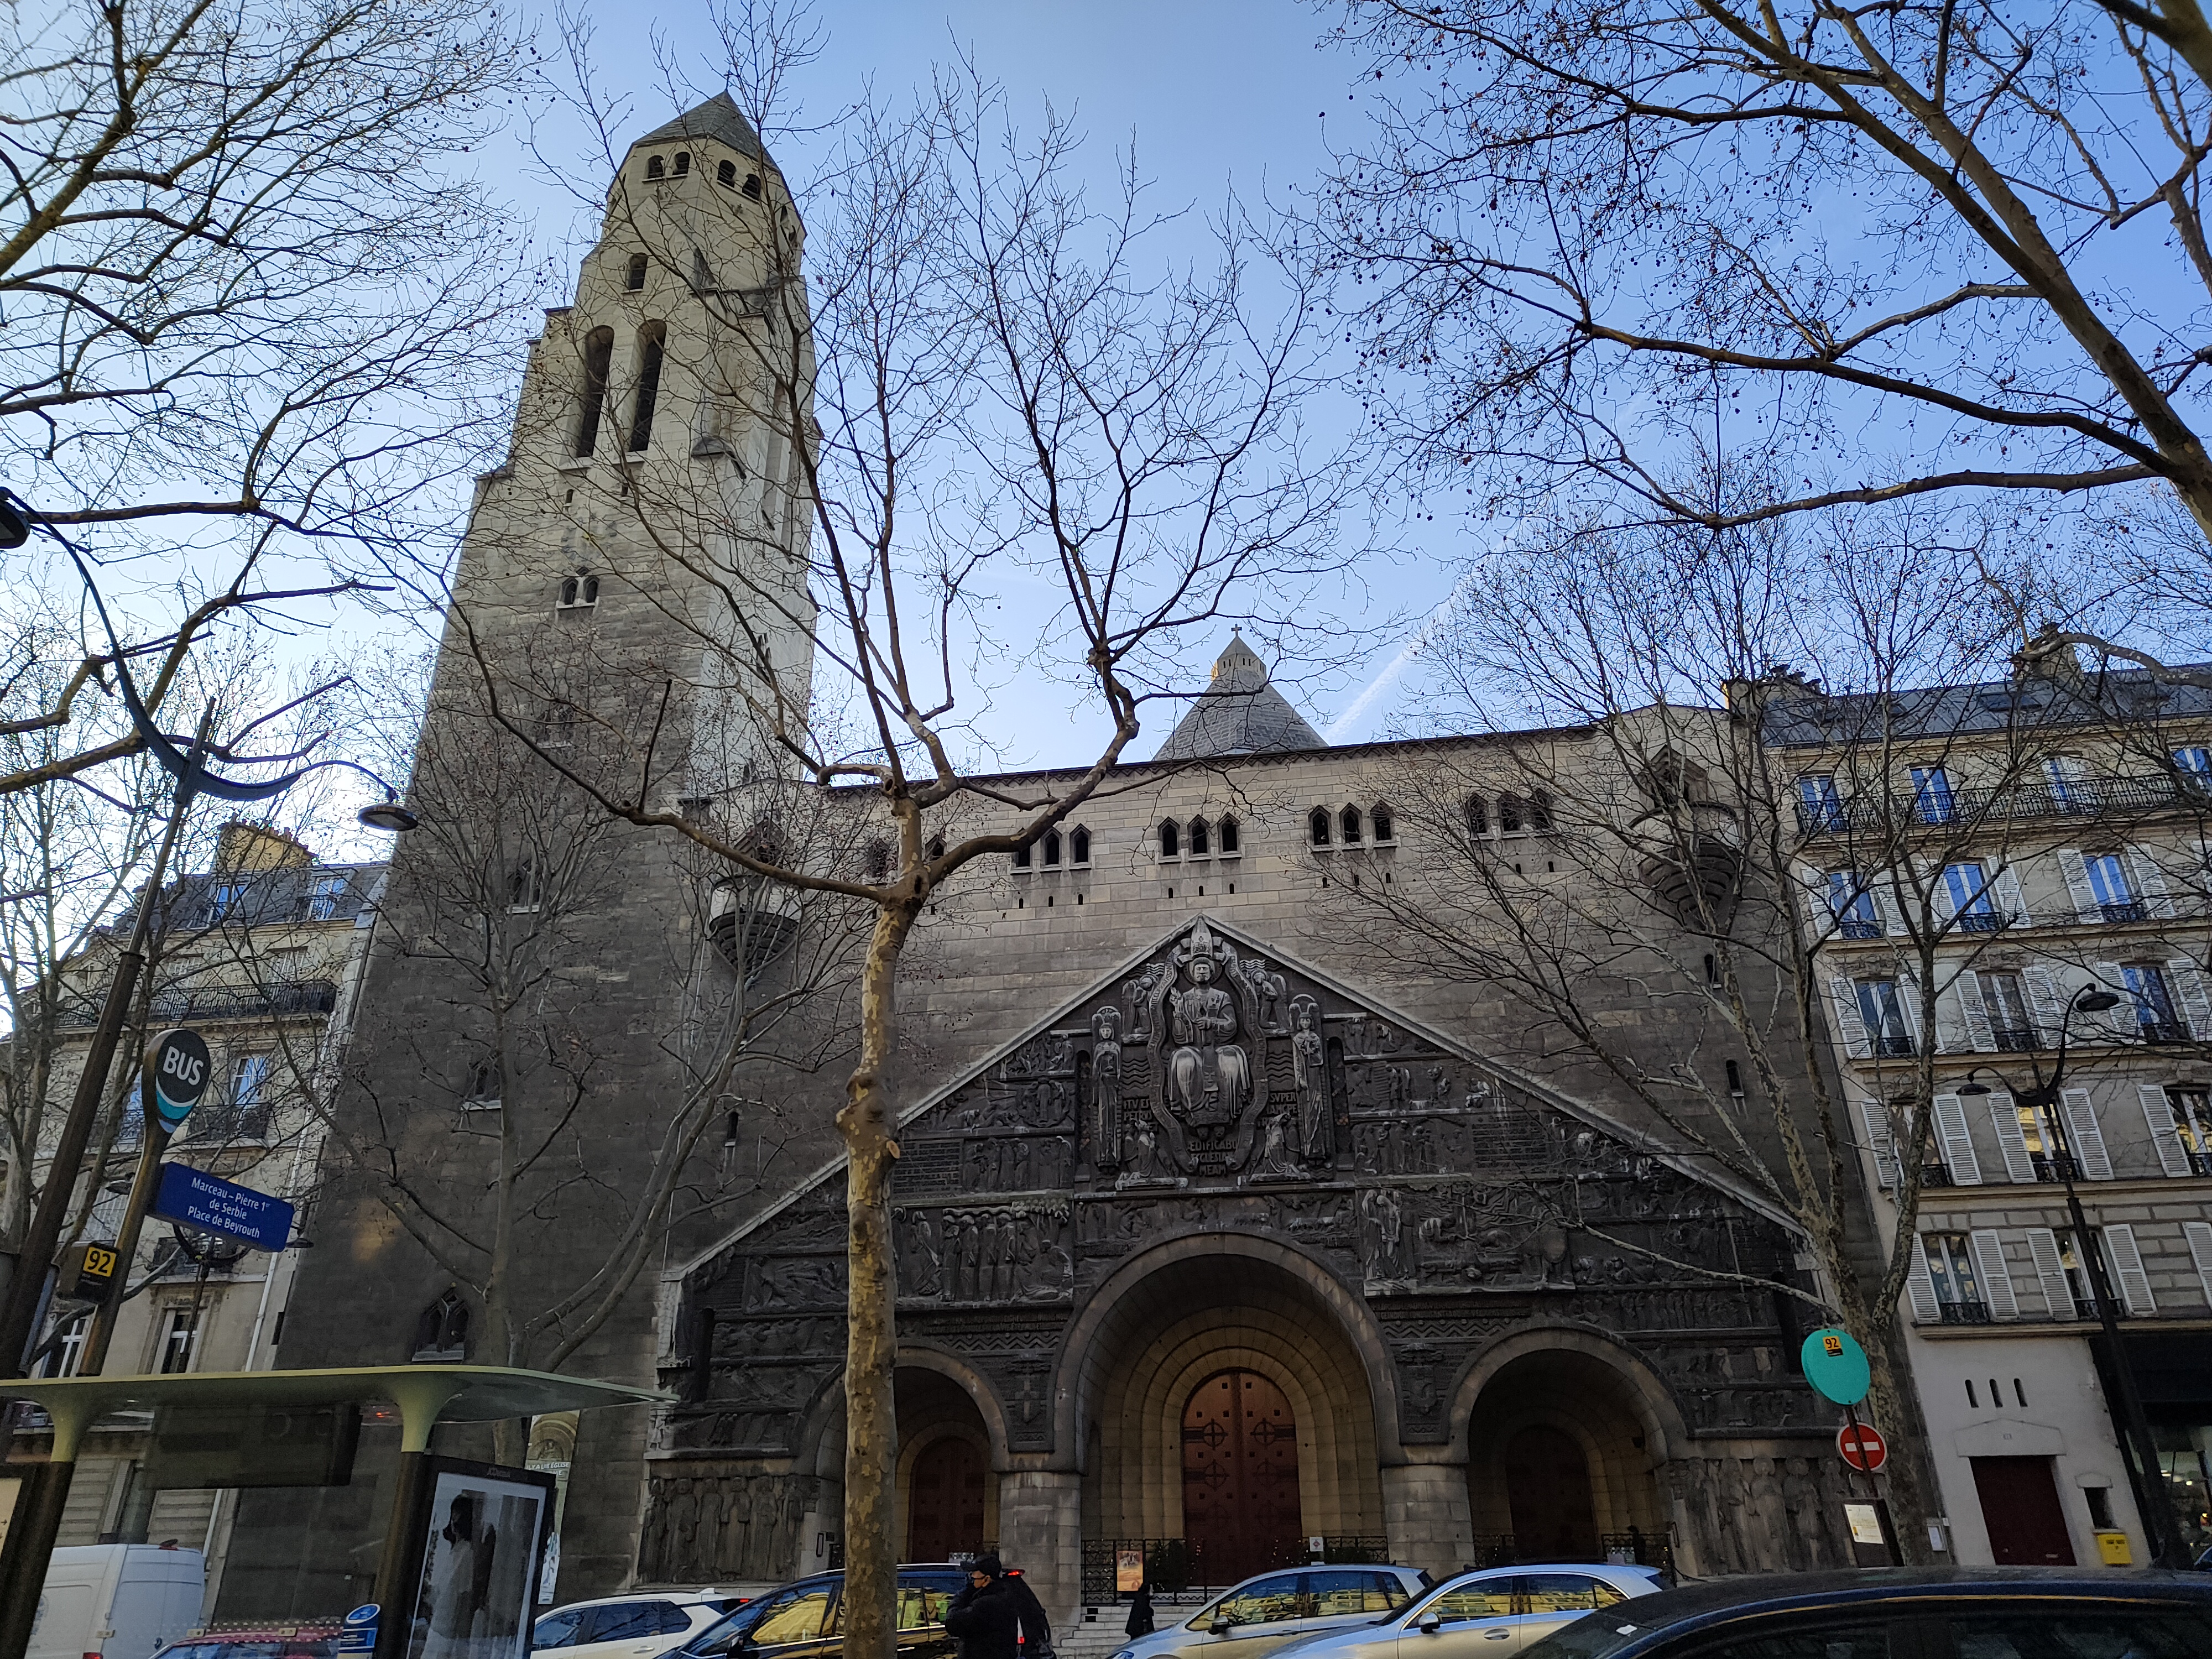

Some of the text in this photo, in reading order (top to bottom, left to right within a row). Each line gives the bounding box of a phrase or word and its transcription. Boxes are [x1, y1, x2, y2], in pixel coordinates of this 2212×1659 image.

[163, 1046, 204, 1086] BUS
[191, 1177, 227, 1198] Marceau
[235, 1192, 259, 1209] Pierre
[187, 1206, 260, 1238] Place de Beyrouth
[209, 1199, 247, 1219] de Serbie
[87, 1250, 111, 1274] 92
[1825, 1338, 1839, 1348] 92
